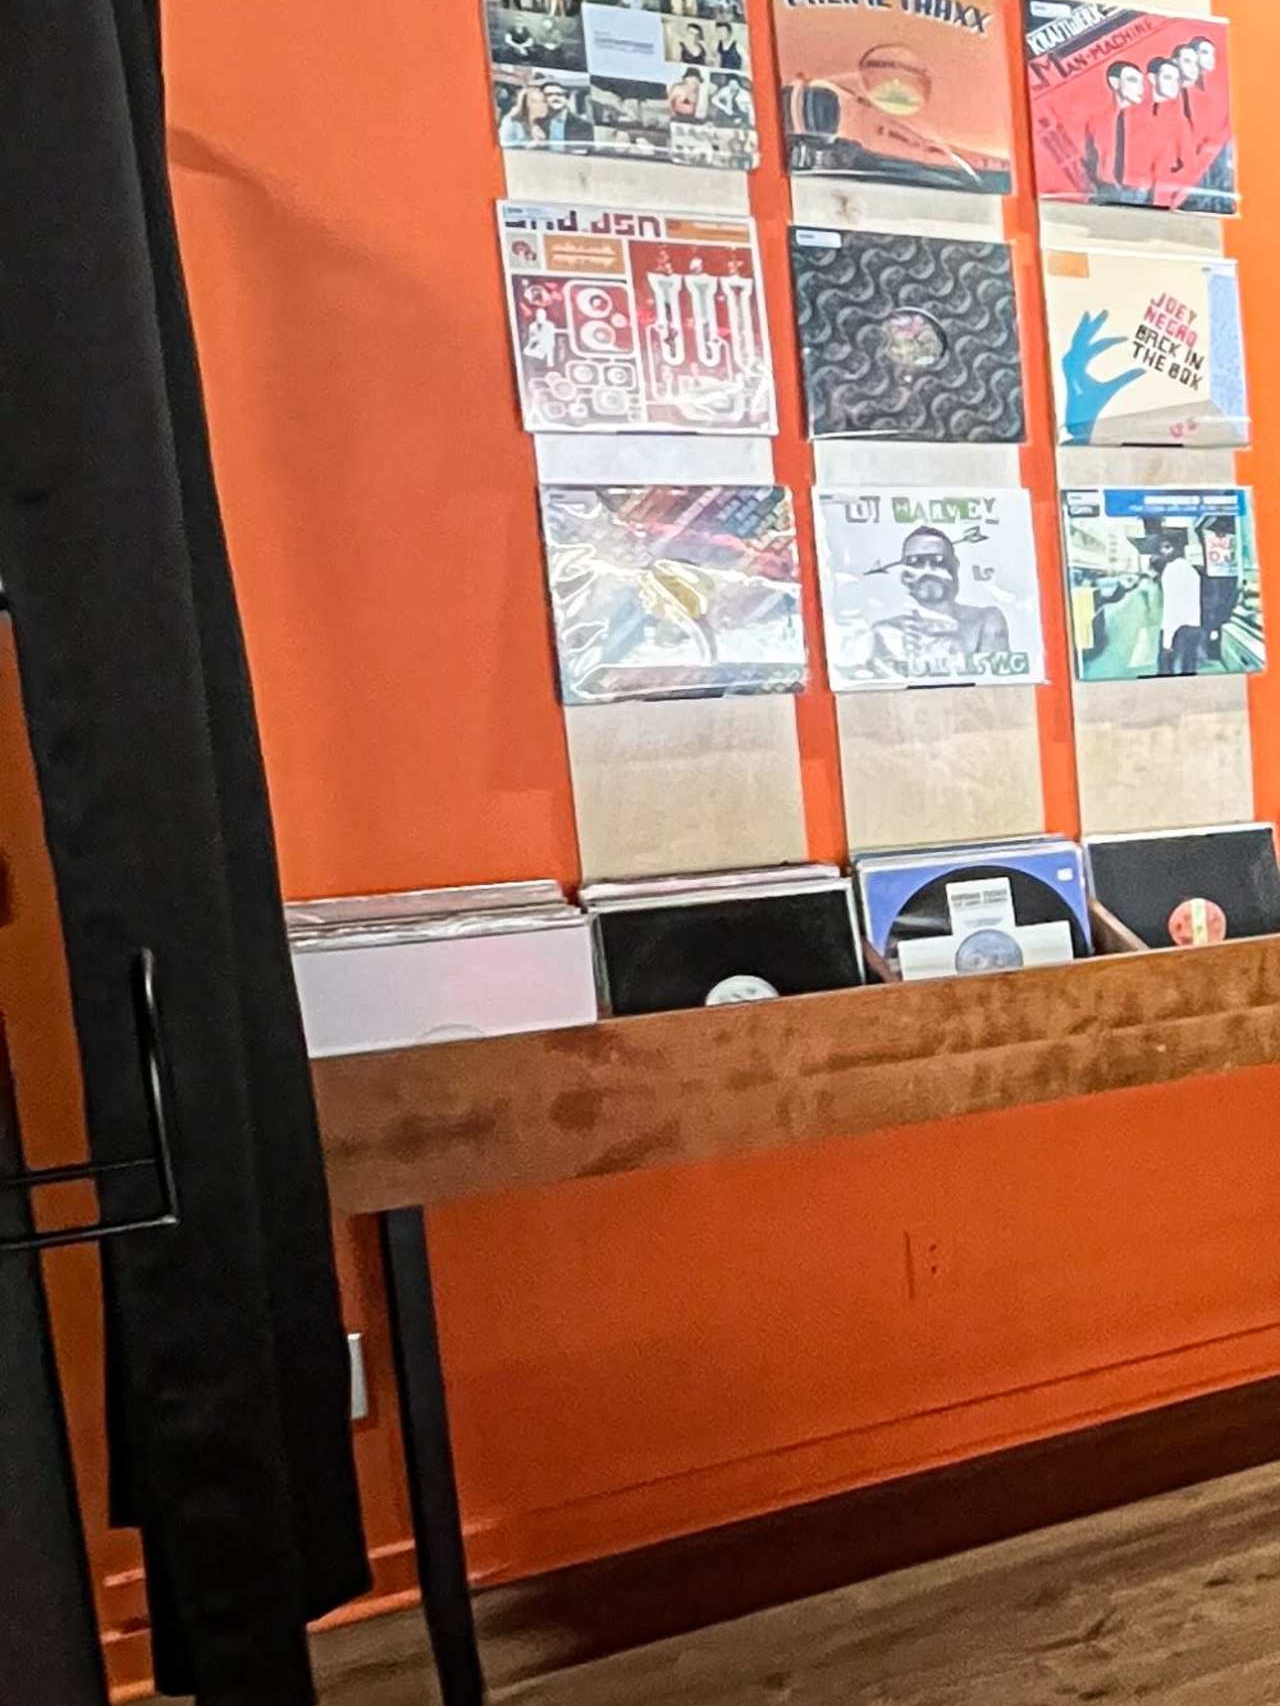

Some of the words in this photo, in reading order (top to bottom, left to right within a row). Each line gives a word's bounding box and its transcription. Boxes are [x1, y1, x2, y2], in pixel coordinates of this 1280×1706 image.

[1143, 305, 1198, 347] NEGRO
[1149, 293, 1198, 324] JOEY
[1131, 340, 1166, 372] THE
[1167, 362, 1203, 391] BOX
[1134, 324, 1182, 357] BACK
[1184, 348, 1205, 371] IN
